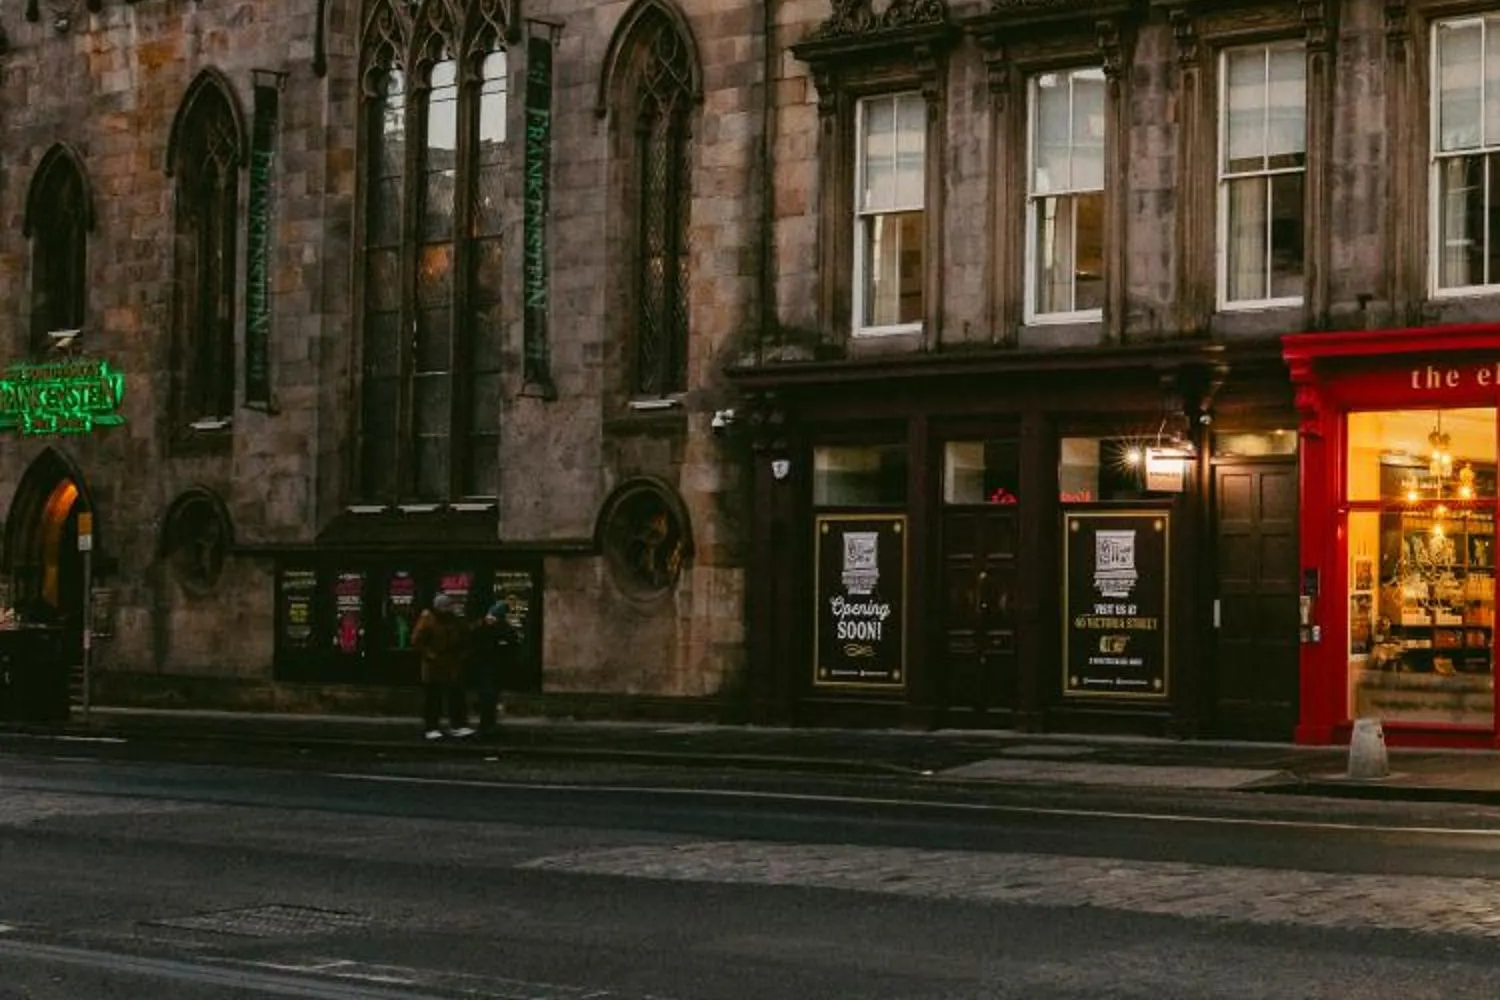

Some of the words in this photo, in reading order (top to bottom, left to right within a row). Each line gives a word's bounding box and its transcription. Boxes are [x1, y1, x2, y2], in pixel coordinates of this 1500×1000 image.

[525, 107, 549, 309] FRANKENSTEIN
[1411, 366, 1460, 389] the
[829, 595, 891, 621] Opening
[837, 621, 882, 640] SOON!
